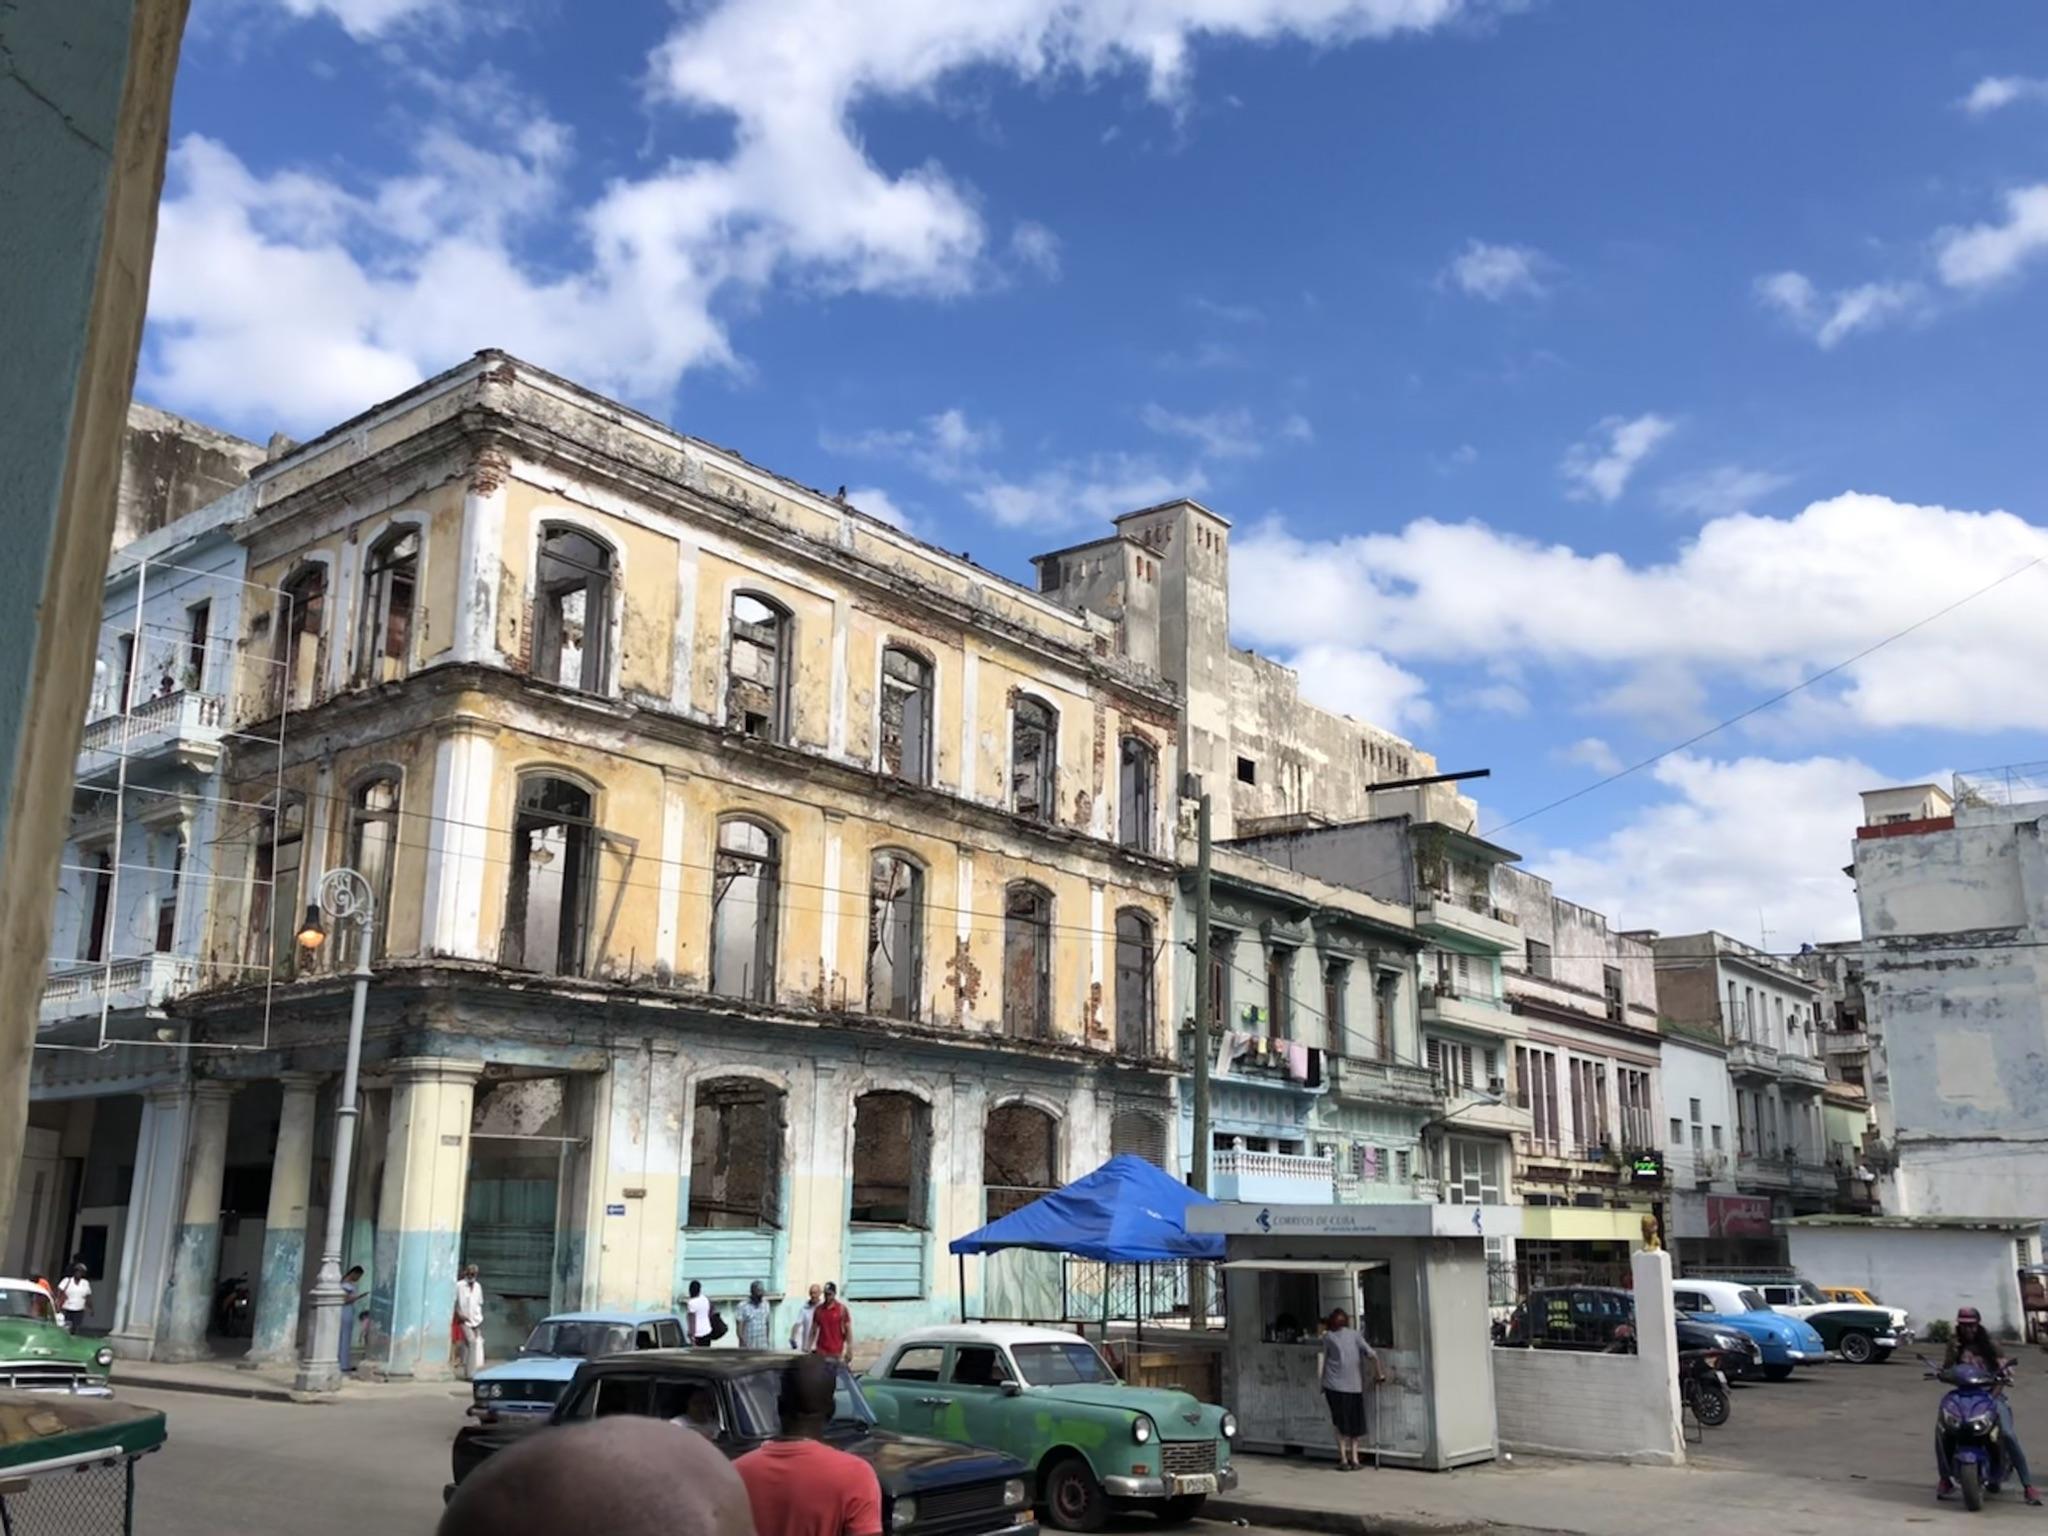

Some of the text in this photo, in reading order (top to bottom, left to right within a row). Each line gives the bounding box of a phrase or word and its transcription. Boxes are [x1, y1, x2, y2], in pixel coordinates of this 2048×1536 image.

[1273, 1215, 1356, 1226] CORREOS DE CUBA
